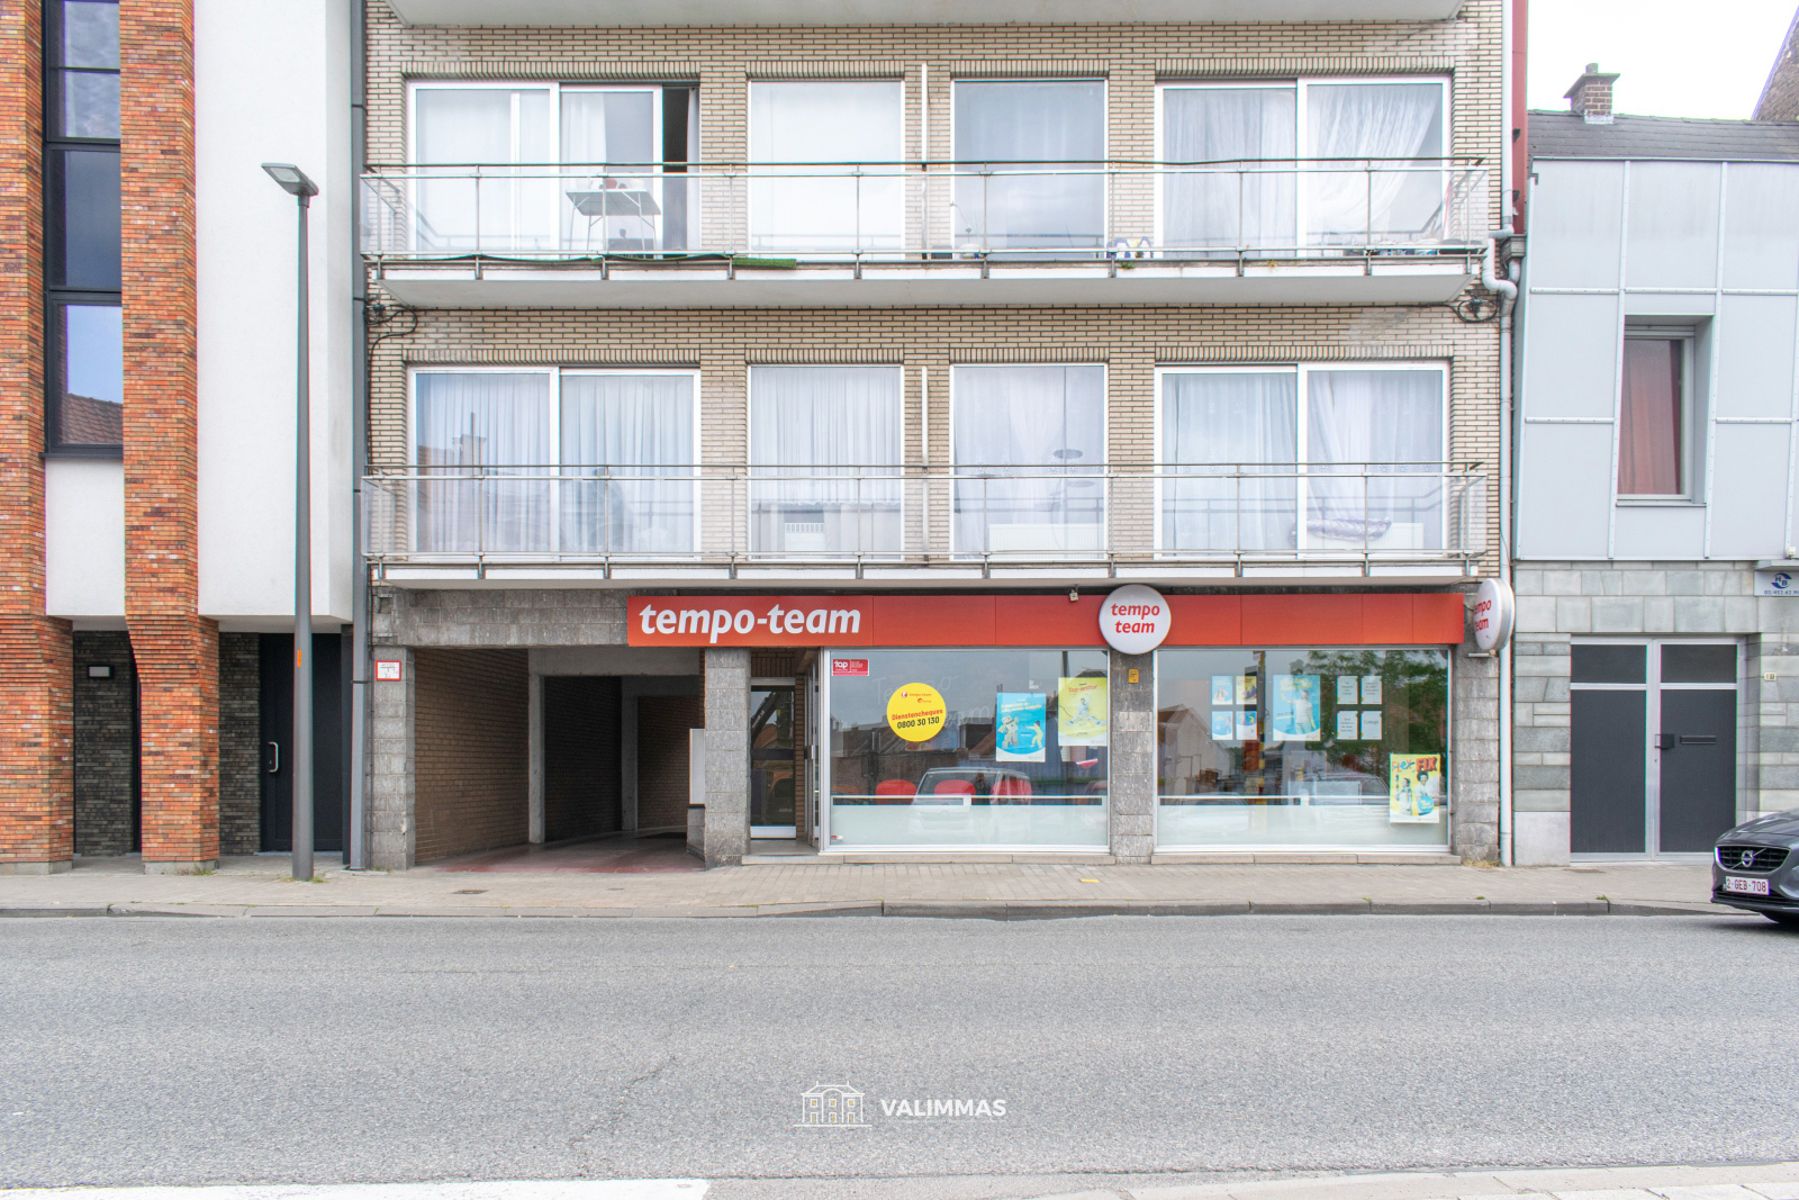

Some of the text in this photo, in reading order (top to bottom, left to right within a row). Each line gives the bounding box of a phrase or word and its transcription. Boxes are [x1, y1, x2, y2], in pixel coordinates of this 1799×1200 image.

[1111, 603, 1160, 620] tempo
[1473, 600, 1492, 617] empo
[639, 604, 861, 644] tempo-team
[1115, 620, 1155, 633] team
[1475, 618, 1489, 631] eam
[896, 716, 940, 729] 0800 30 130
